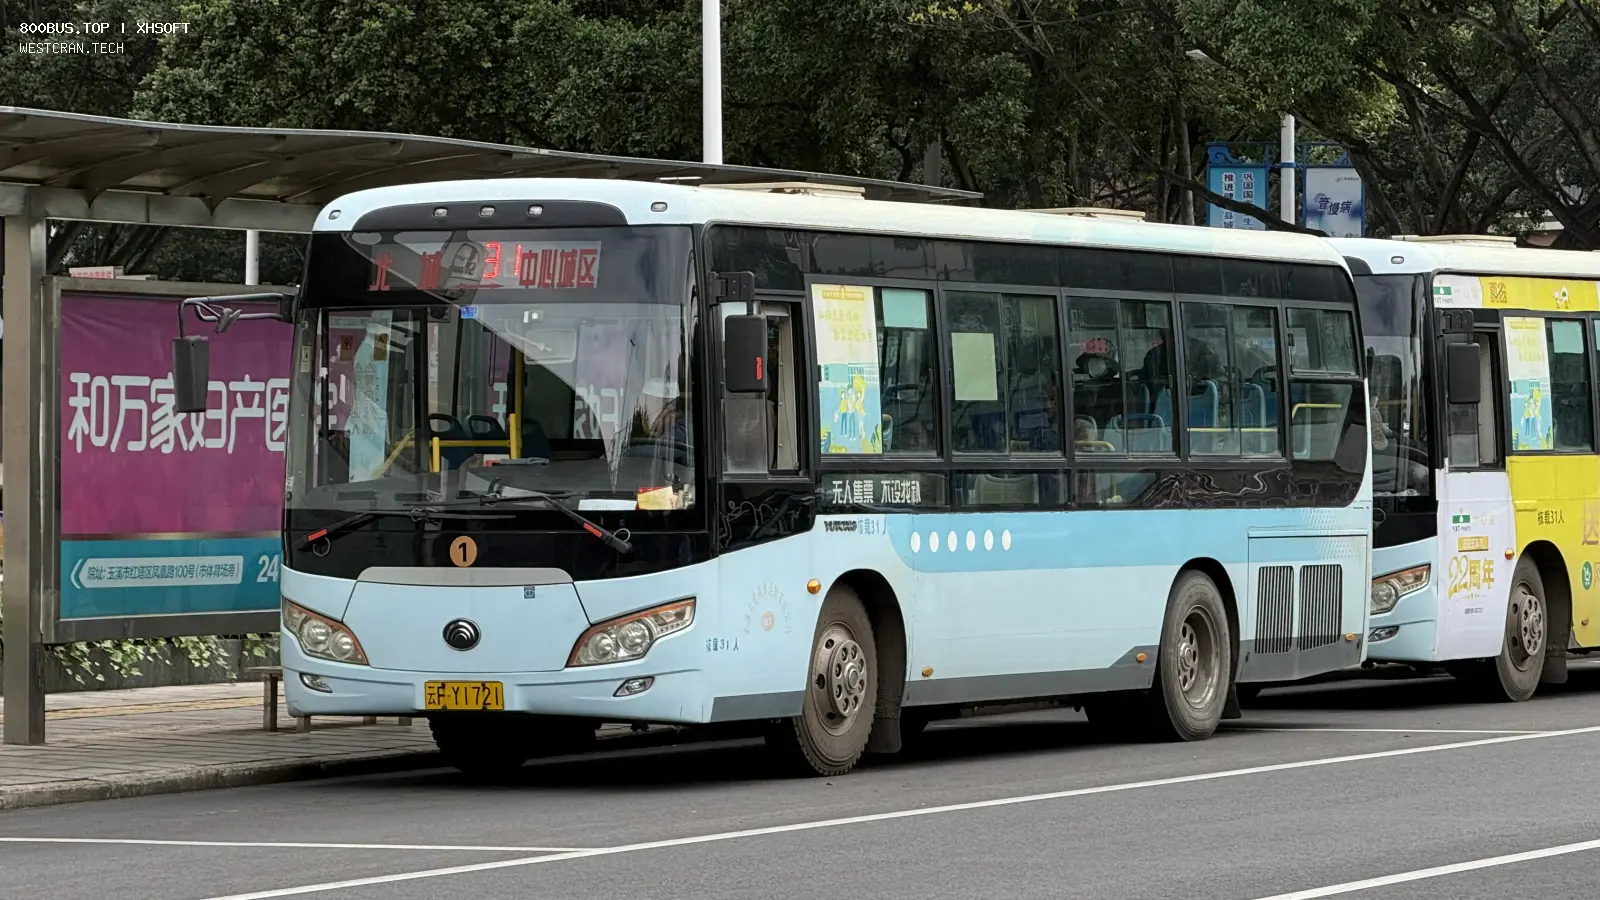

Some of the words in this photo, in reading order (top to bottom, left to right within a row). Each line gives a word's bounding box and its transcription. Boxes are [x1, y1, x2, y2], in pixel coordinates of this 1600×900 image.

[482, 240, 522, 280] 31
[518, 248, 598, 290] 中心城区
[832, 480, 874, 504] 无人售票
[1537, 510, 1565, 526] 核载31人
[458, 542, 468, 562] 1
[1448, 555, 1495, 599] 22周年
